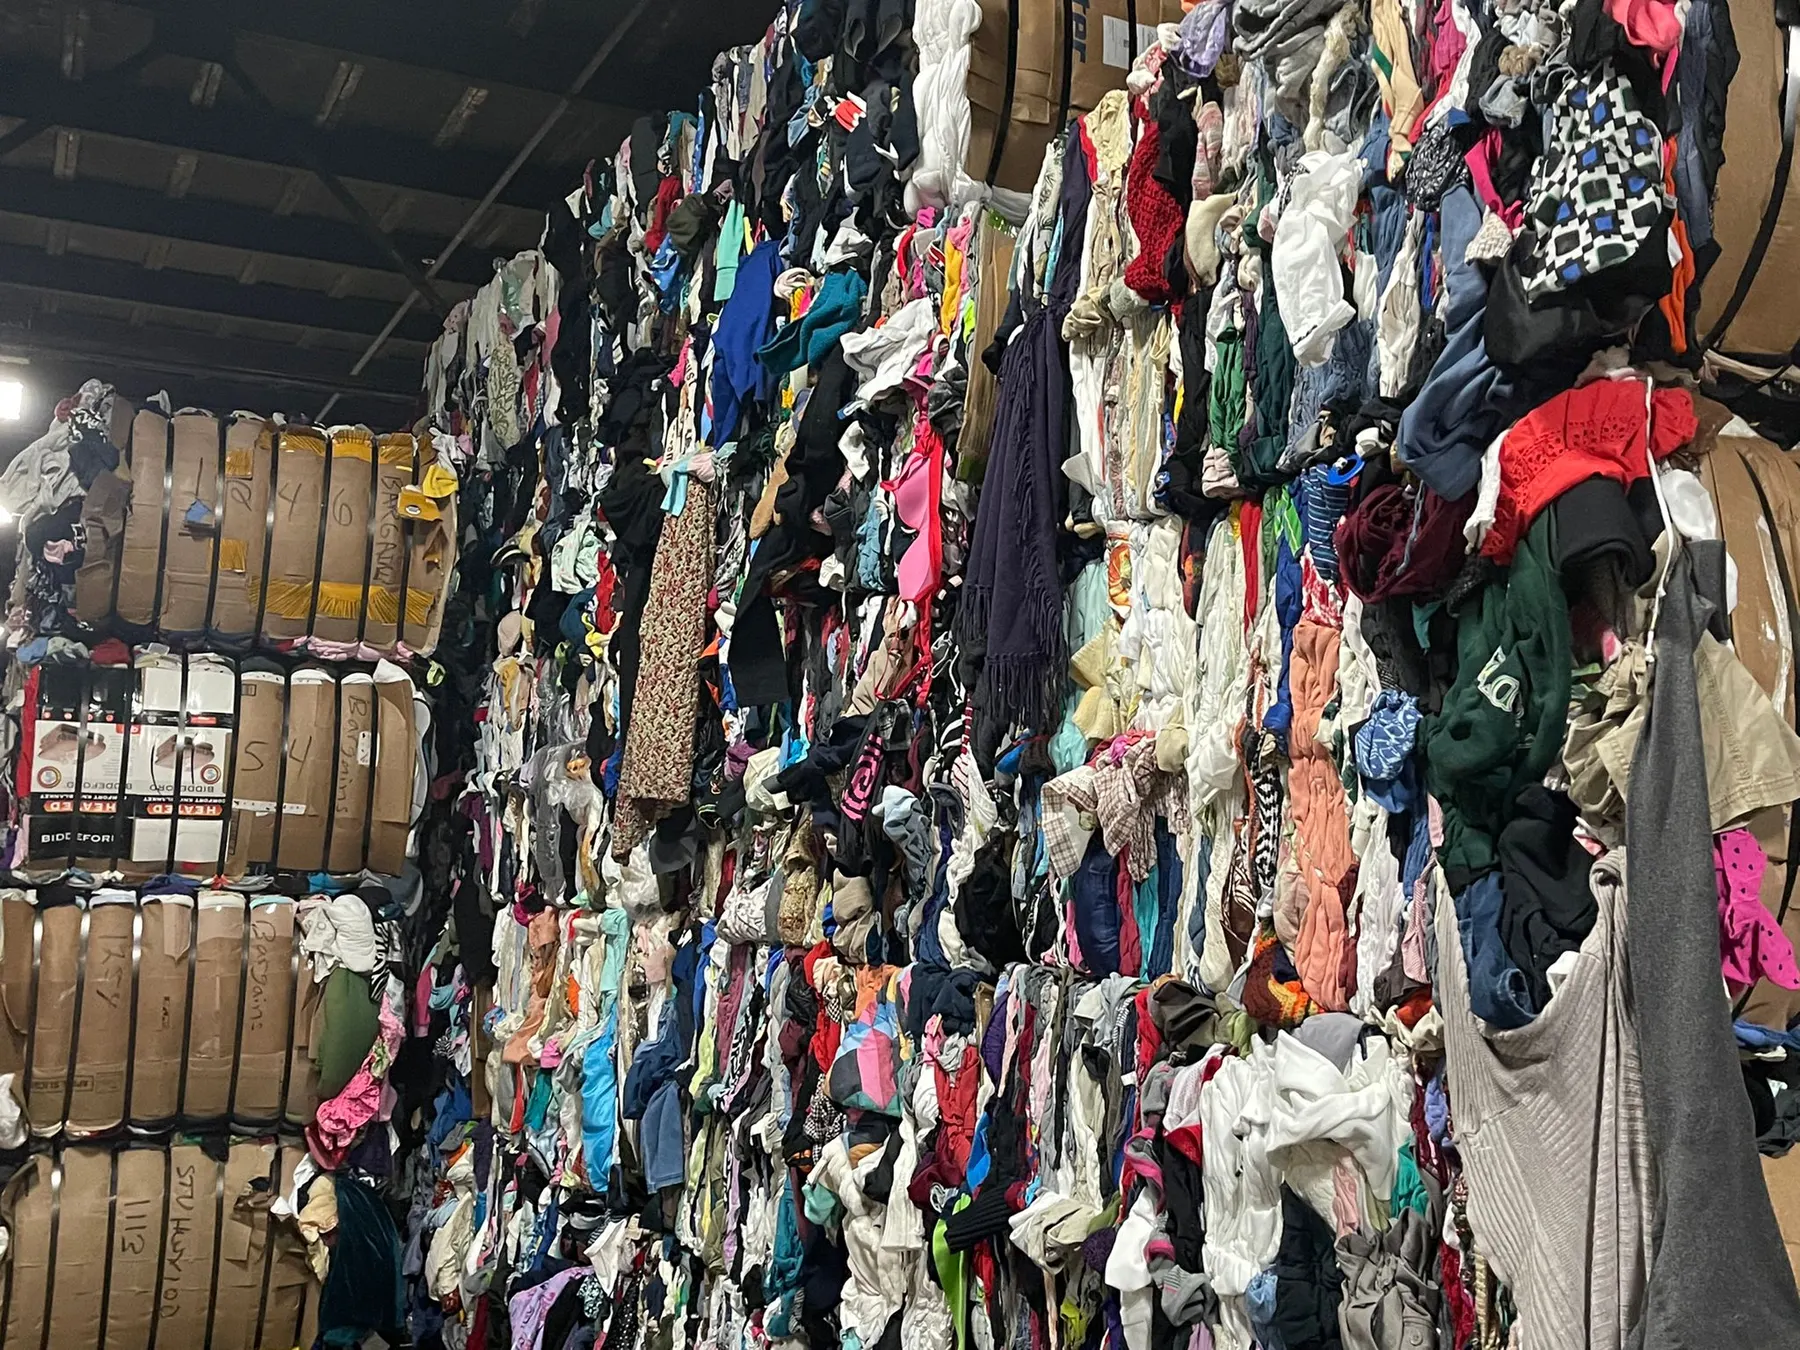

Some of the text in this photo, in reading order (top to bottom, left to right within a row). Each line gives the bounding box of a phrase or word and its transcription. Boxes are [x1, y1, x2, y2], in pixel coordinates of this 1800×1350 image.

[50, 801, 116, 812] HEAED
[41, 832, 114, 843] BIDDEFOR
[121, 1200, 151, 1255] 1113
